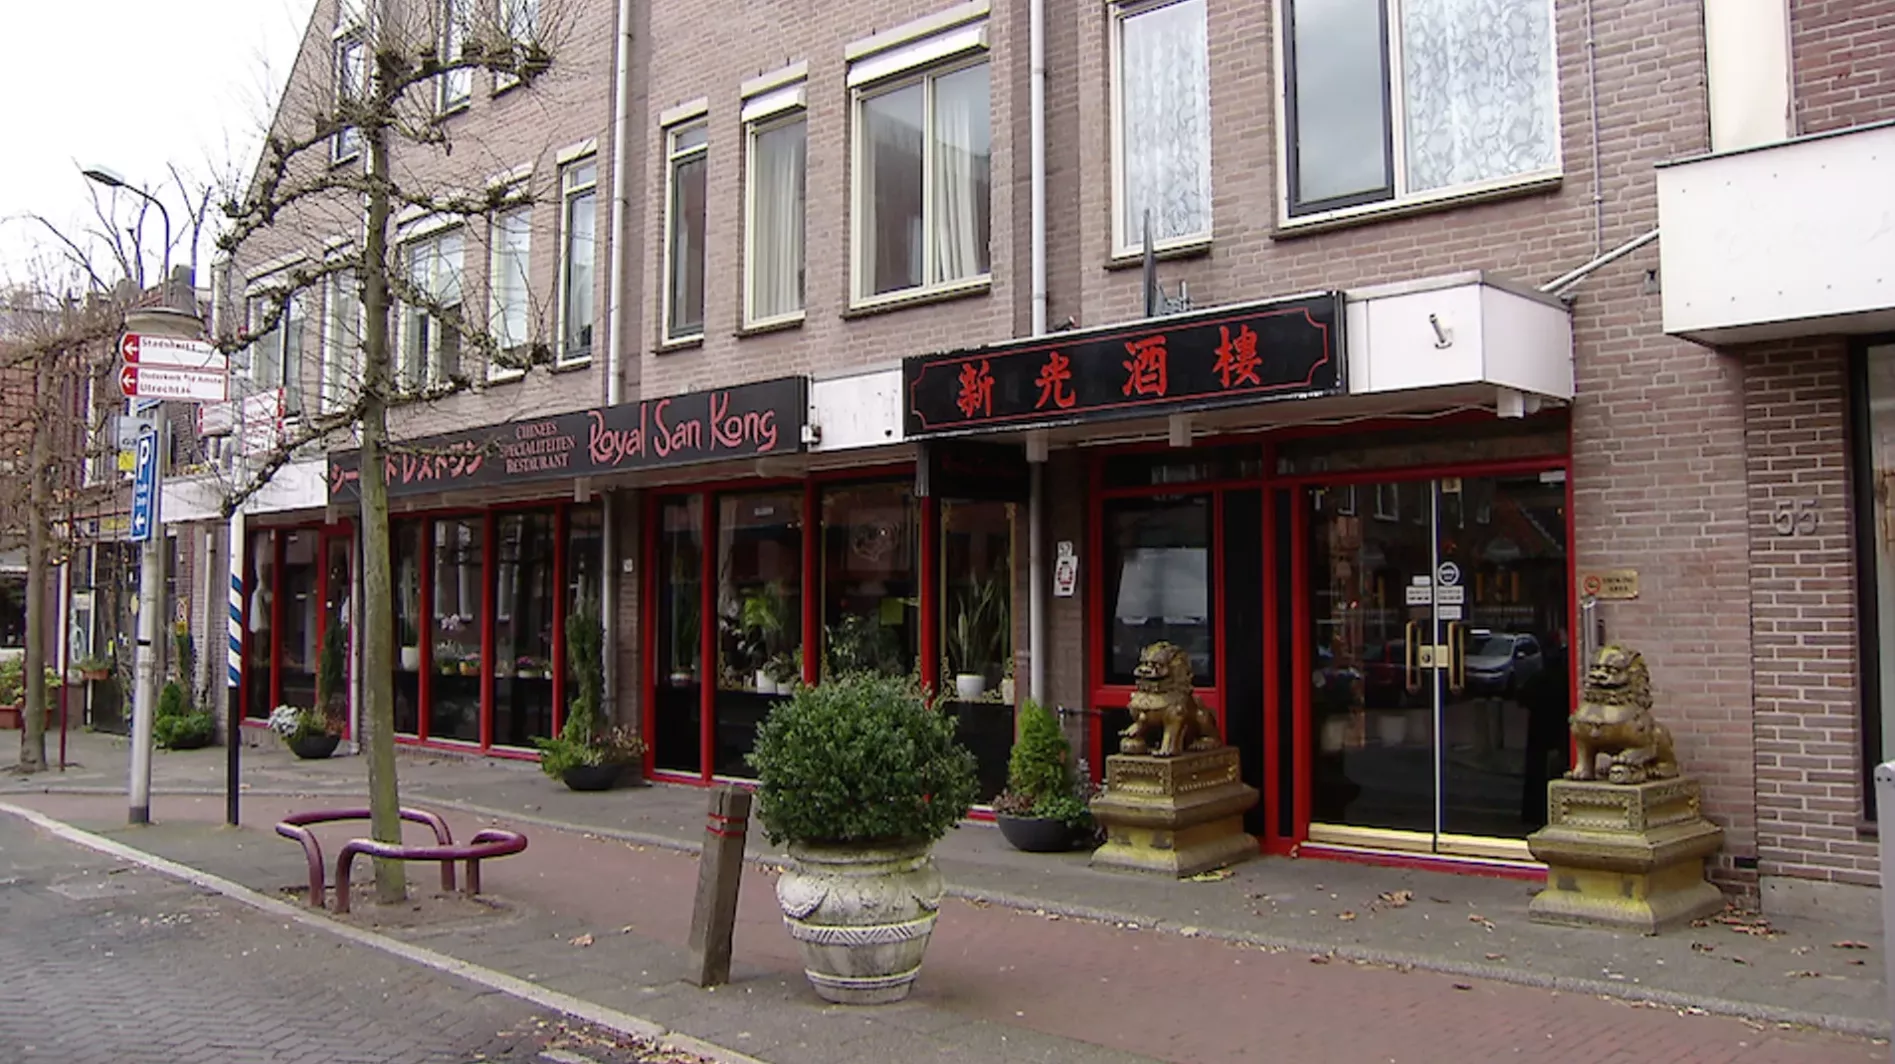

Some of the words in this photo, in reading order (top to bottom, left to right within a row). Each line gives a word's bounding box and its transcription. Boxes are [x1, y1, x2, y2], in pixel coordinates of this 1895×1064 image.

[516, 421, 558, 440] CHINEES
[587, 403, 647, 466] Royal
[653, 399, 701, 457] San
[710, 392, 777, 452] Kong
[506, 452, 568, 474] RESTAURANT
[1773, 499, 1817, 536] 55
